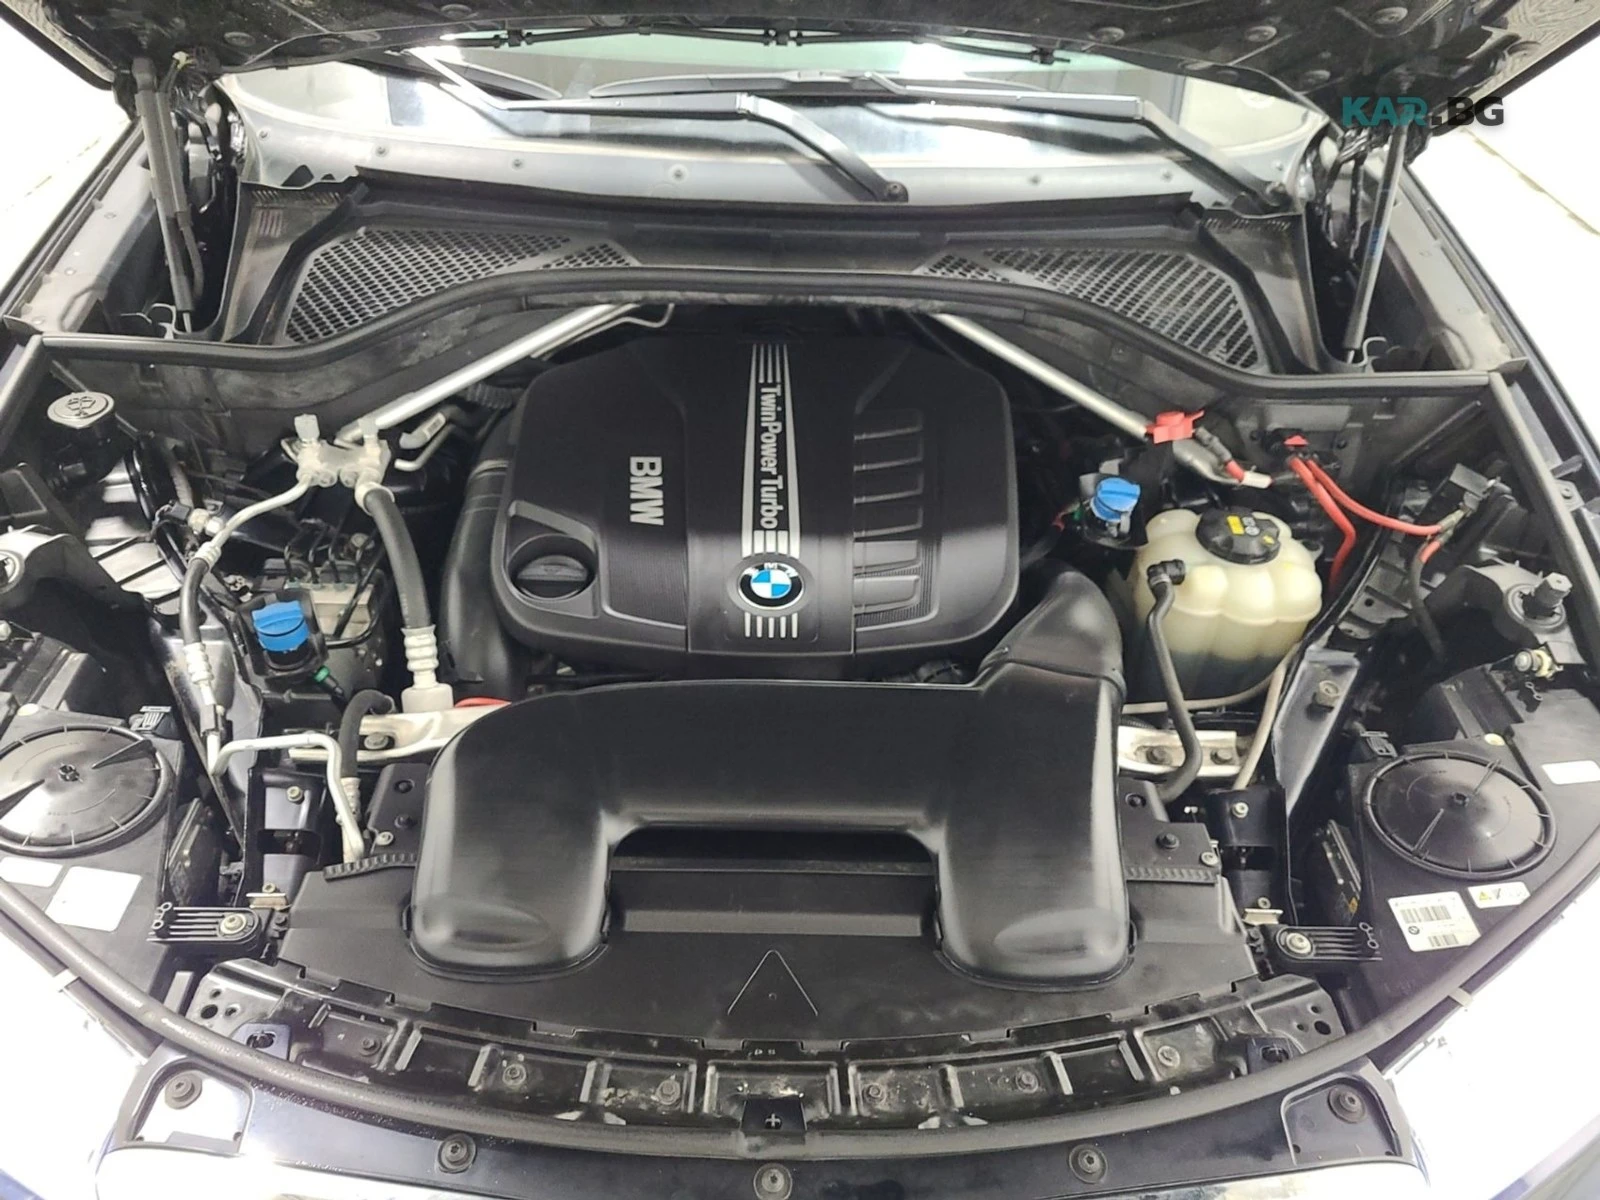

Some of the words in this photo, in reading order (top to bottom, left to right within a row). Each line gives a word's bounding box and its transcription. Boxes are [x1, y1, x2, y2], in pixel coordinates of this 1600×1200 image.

[760, 384, 782, 475] TwinPower
[630, 456, 664, 526] BMW
[760, 475, 785, 529] Turbo
